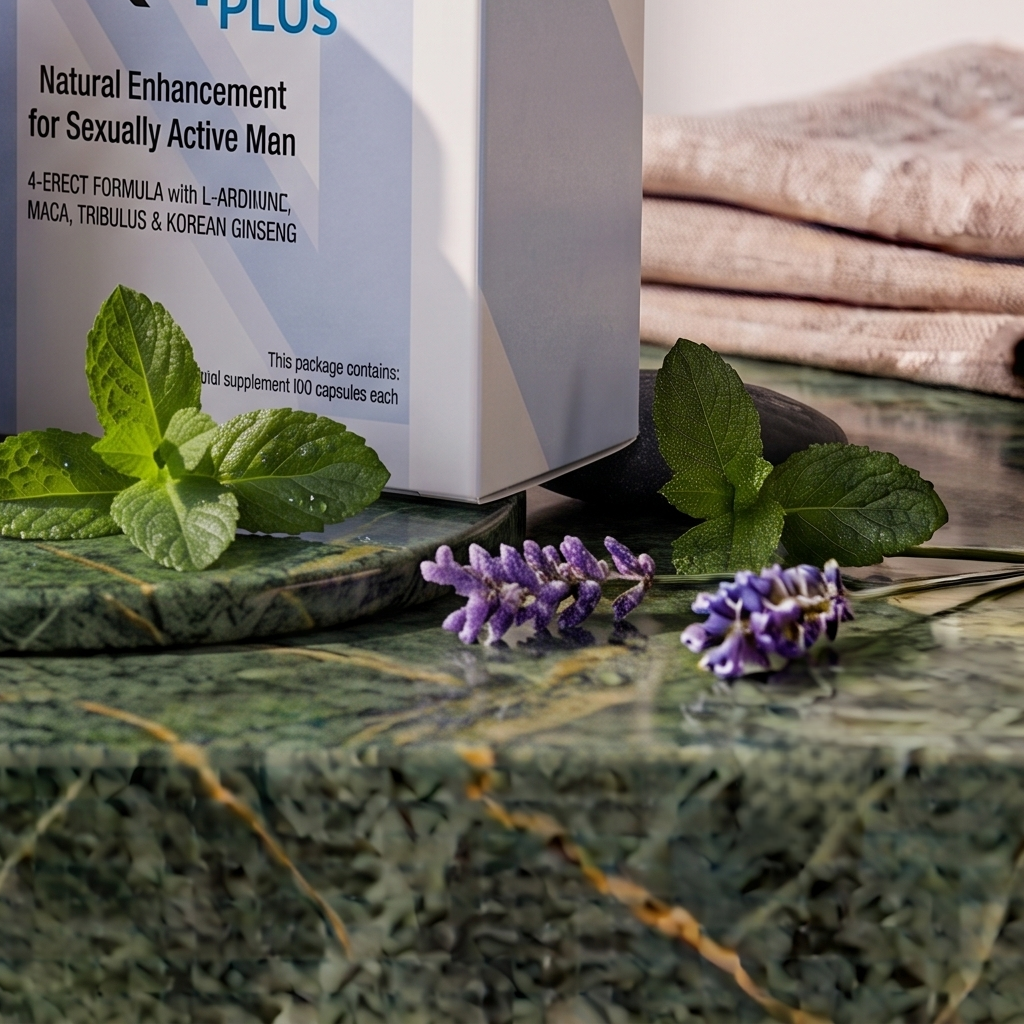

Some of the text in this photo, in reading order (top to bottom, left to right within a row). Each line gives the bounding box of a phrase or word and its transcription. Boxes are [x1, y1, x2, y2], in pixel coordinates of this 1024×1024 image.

[40, 64, 287, 110] Natural Enhancement
[28, 108, 60, 138] for
[66, 110, 161, 152] Sexually
[167, 118, 238, 152] Active
[27, 171, 88, 194] 4-ERECT
[93, 176, 163, 201] FORMULA
[168, 184, 197, 204] with
[27, 200, 297, 243] MACA, TRIBULUS & KOREAN GINSENG
[268, 351, 400, 381] This package contains:
[224, 373, 290, 392] supplement
[315, 384, 367, 402] capsules
[370, 388, 398, 405] each
